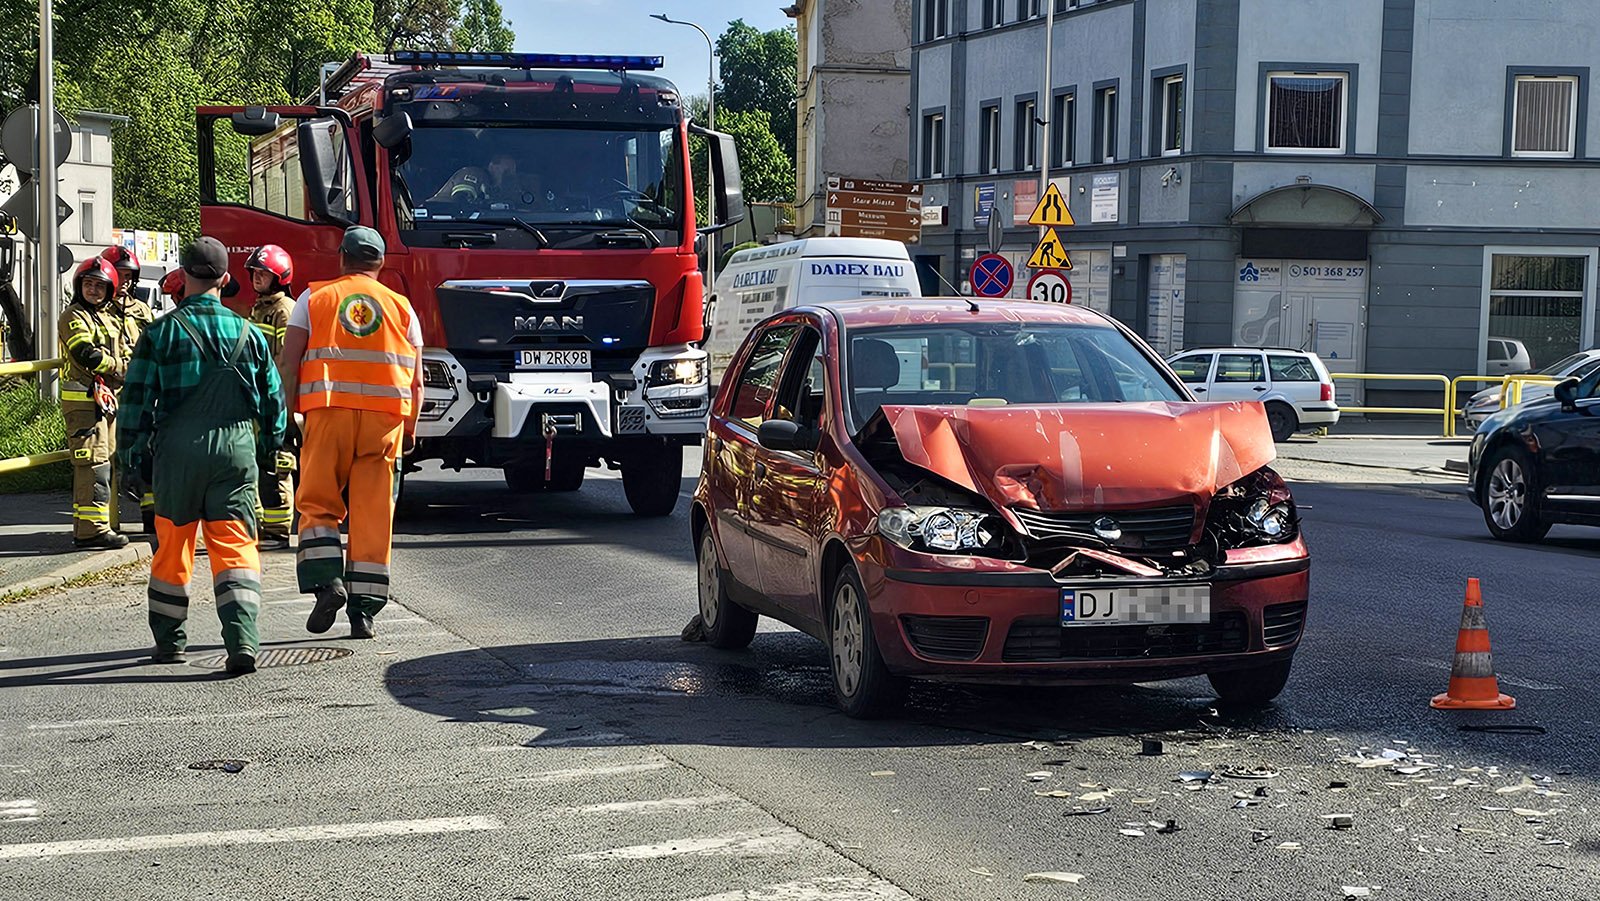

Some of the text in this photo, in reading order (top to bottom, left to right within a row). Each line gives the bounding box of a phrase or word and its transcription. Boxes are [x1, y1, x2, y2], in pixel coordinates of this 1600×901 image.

[811, 263, 904, 277] DAREX BAU
[1303, 266, 1364, 277] 501 368 257
[1034, 281, 1065, 303] 30
[514, 315, 584, 331] MAN
[523, 351, 588, 366] DW 2RK98
[1079, 591, 1114, 618] DJ
